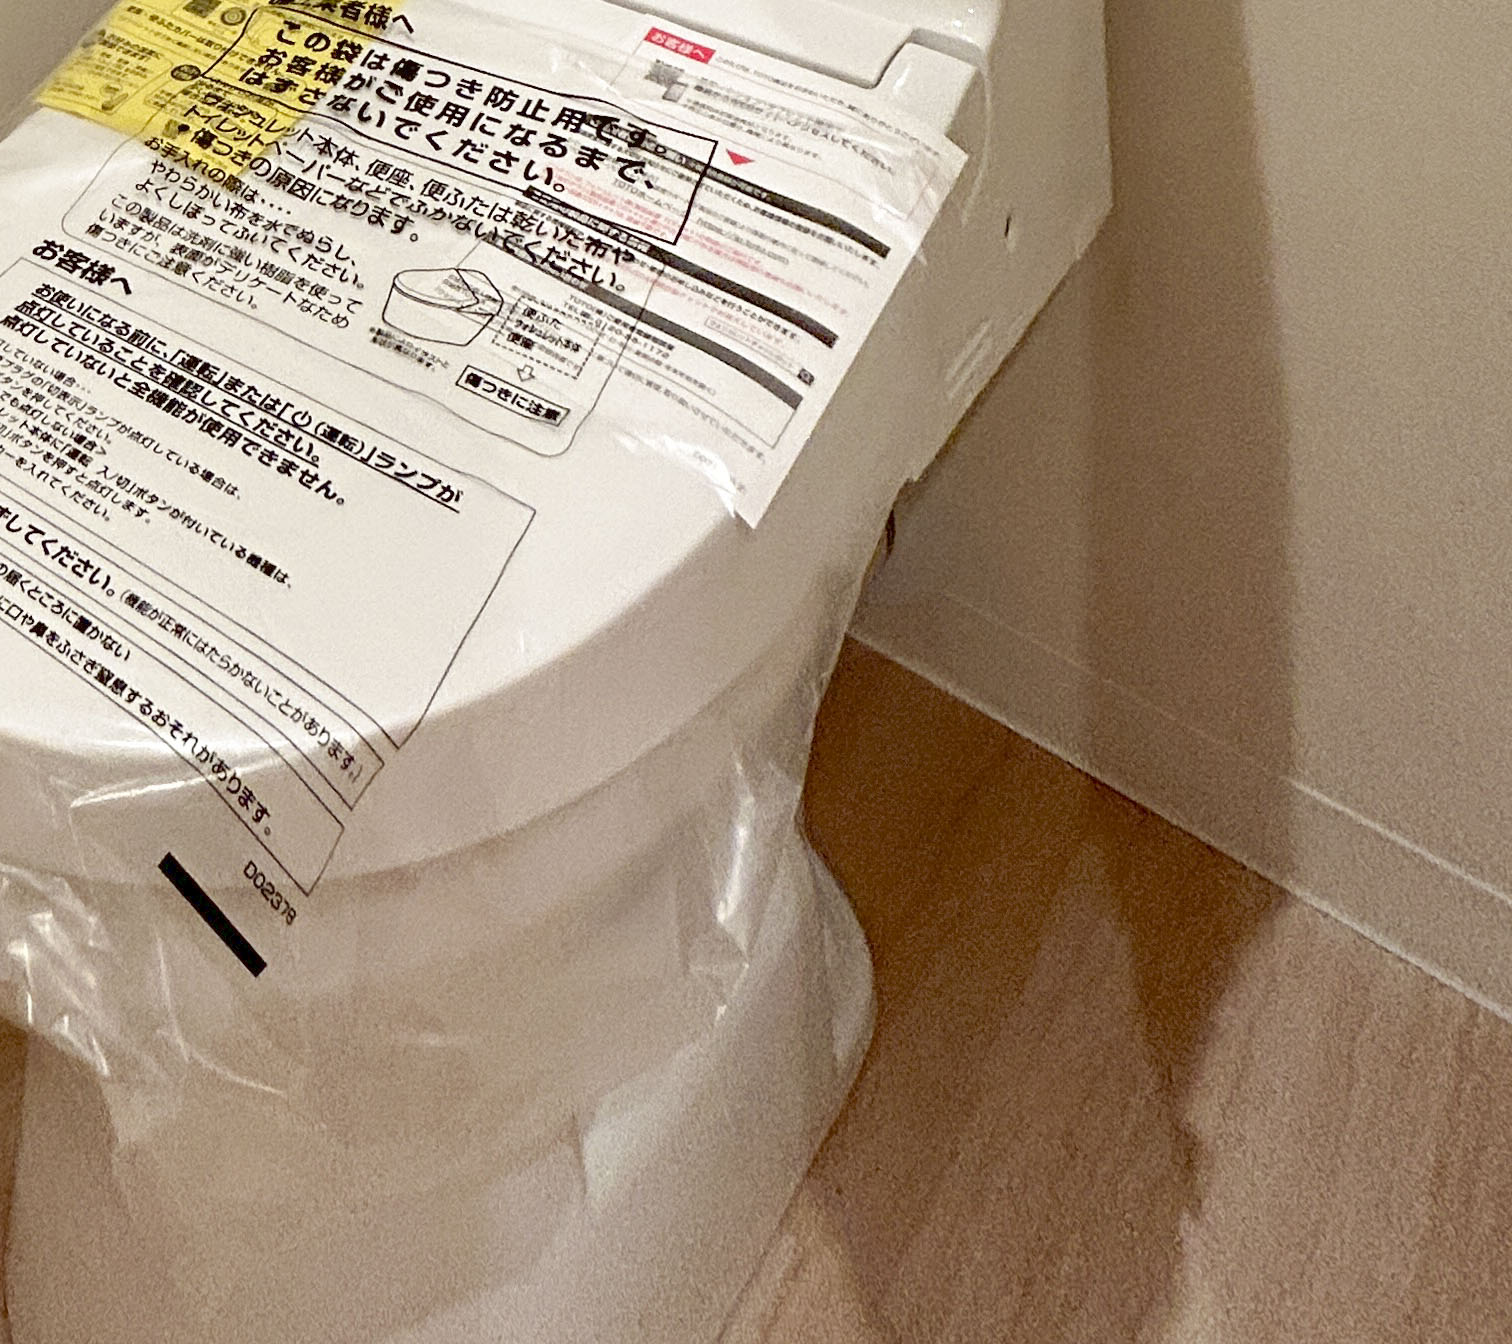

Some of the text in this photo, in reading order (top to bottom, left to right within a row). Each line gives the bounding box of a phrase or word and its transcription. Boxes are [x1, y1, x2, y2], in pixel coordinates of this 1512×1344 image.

[32, 239, 132, 295] お客様へ
[0, 313, 345, 506] 点灯していないと全機能が使用できません。
[14, 299, 320, 463] 点灯していることを確認してください。
[464, 371, 561, 423] 傷つきに注意
[243, 860, 297, 925] D02378
